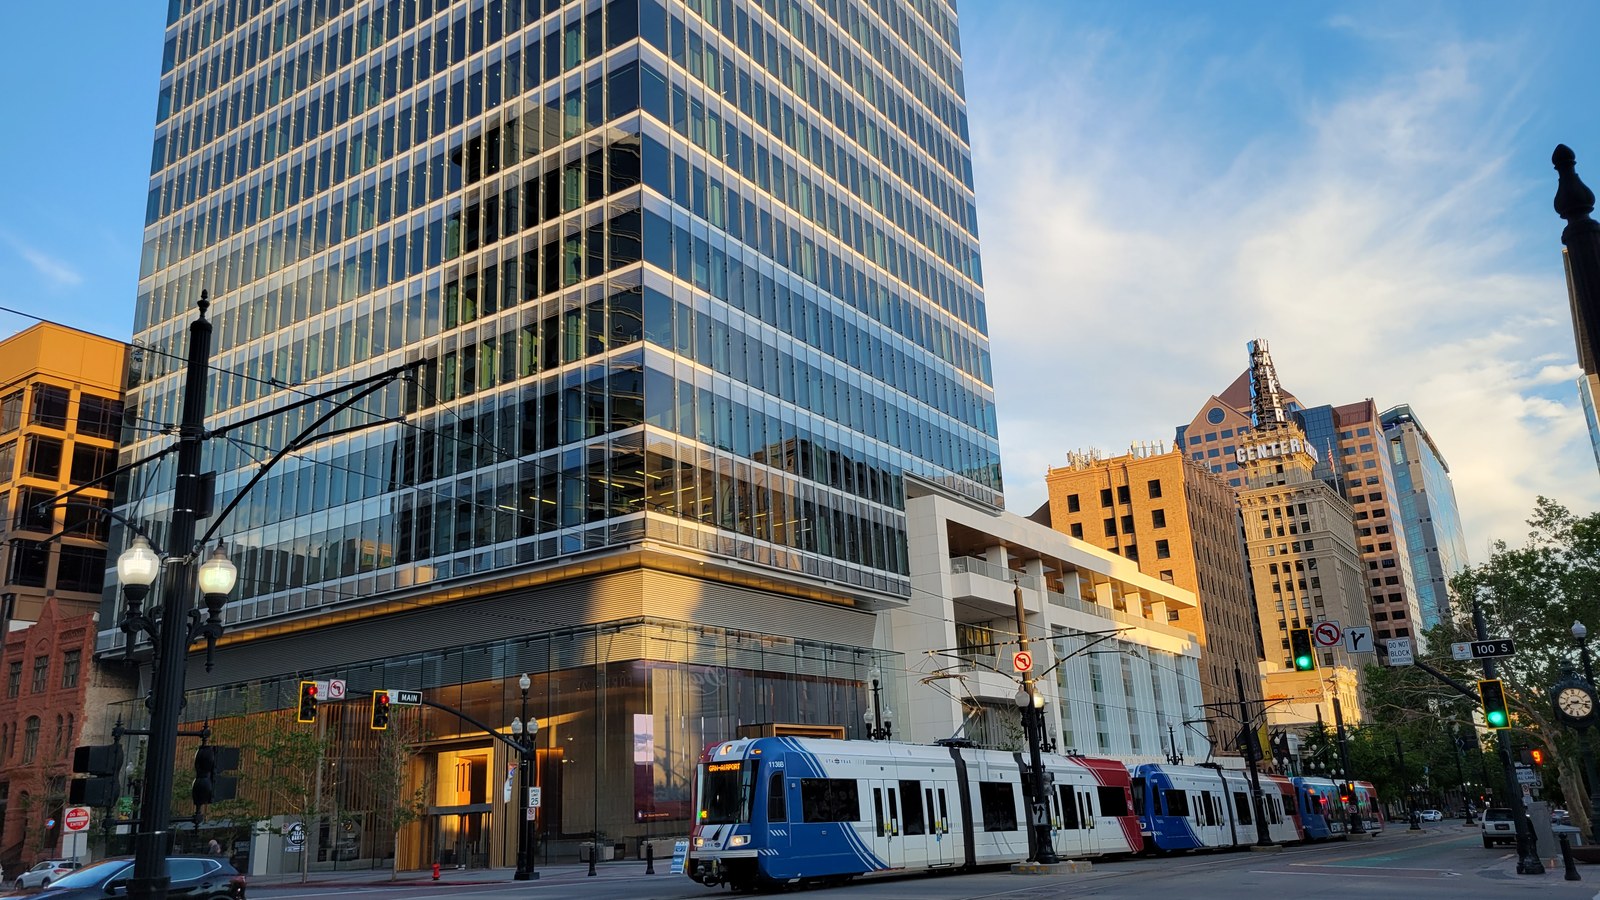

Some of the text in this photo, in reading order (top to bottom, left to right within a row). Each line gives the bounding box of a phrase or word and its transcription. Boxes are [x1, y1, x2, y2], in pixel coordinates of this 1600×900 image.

[1246, 339, 1259, 428] WALKER
[1257, 338, 1285, 422] WALKER
[1236, 437, 1300, 464] CENTER
[1388, 640, 1408, 649] DO NOT
[1476, 644, 1496, 655] 100
[1501, 643, 1508, 653] S
[1390, 649, 1411, 657] BLOCK
[401, 693, 418, 703] MAIN
[1533, 751, 1541, 762] 9
[530, 798, 538, 806] 25
